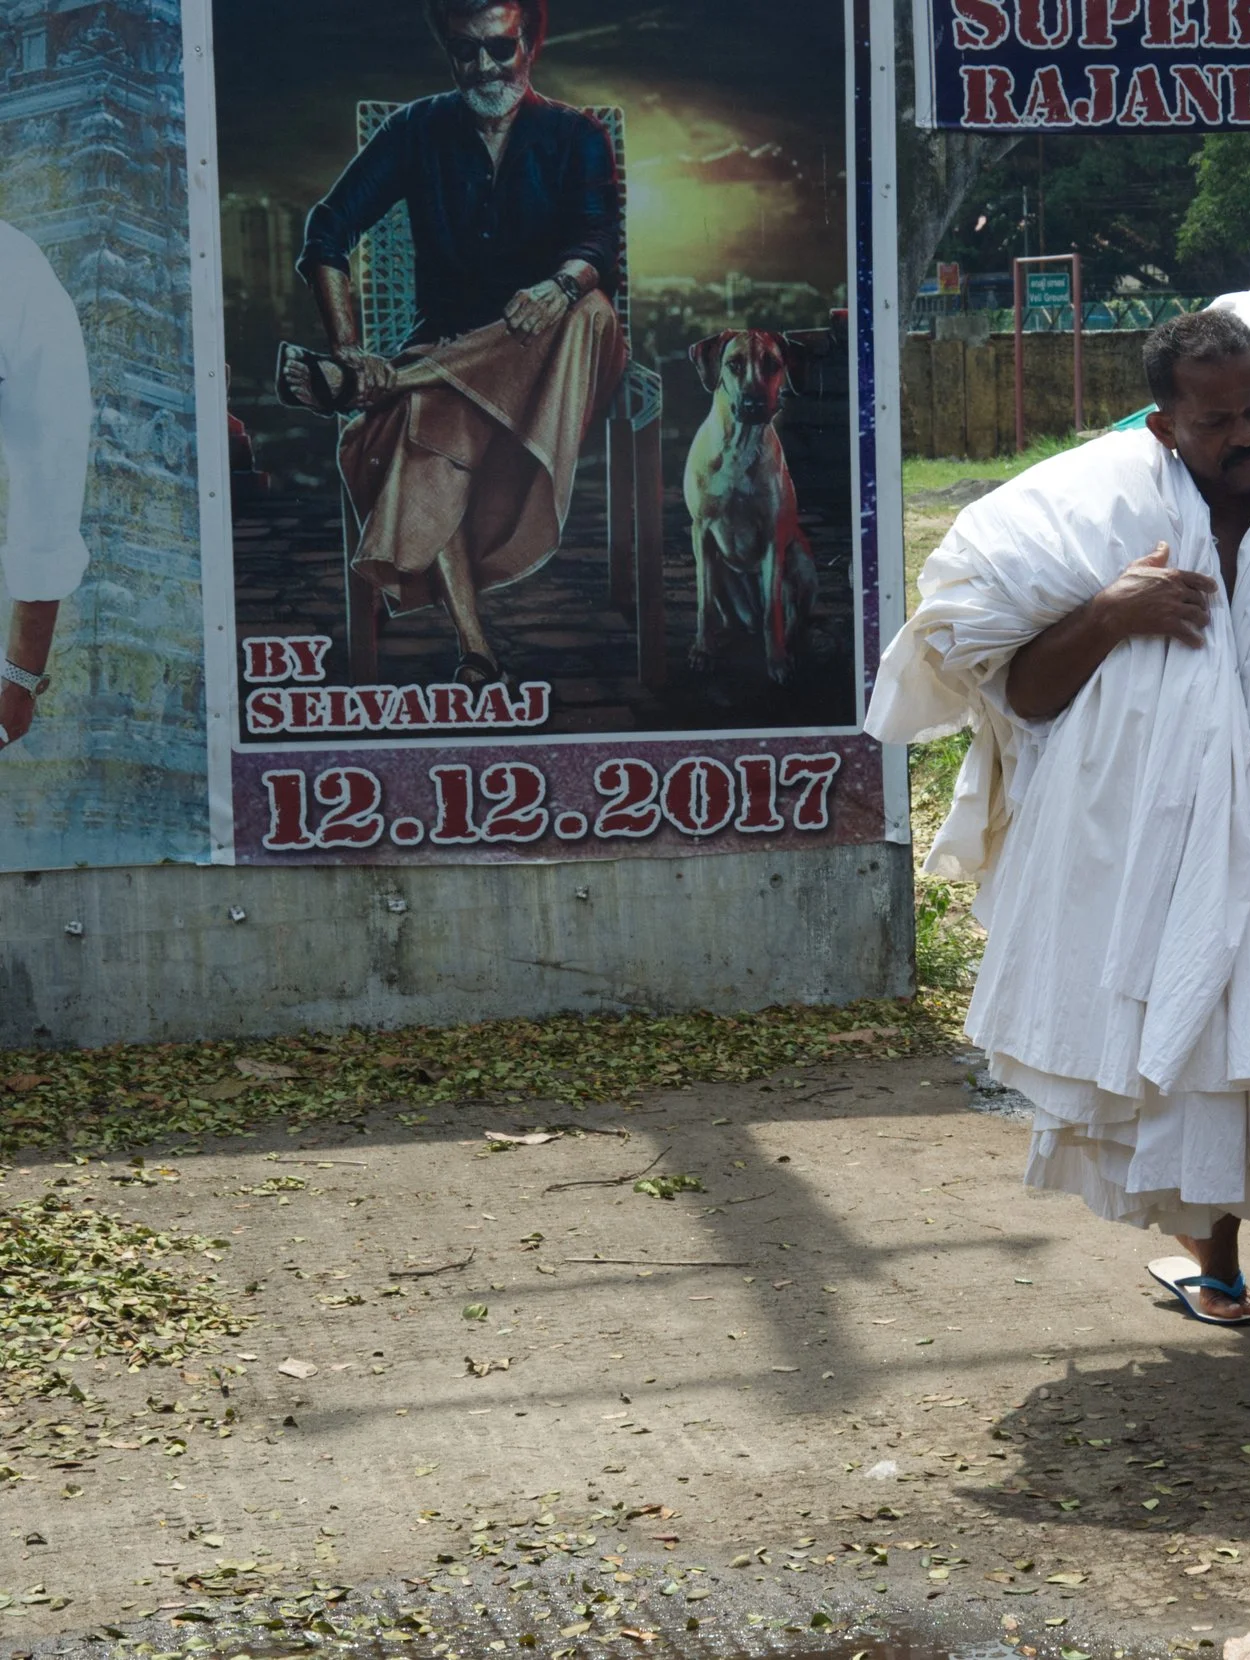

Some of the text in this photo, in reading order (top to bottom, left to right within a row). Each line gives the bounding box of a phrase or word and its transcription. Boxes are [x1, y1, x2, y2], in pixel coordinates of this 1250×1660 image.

[1044, 292, 1069, 302] Ground
[243, 635, 332, 683] BY
[246, 681, 552, 734] SELVARAJ
[262, 752, 840, 850] 12.12.2017
